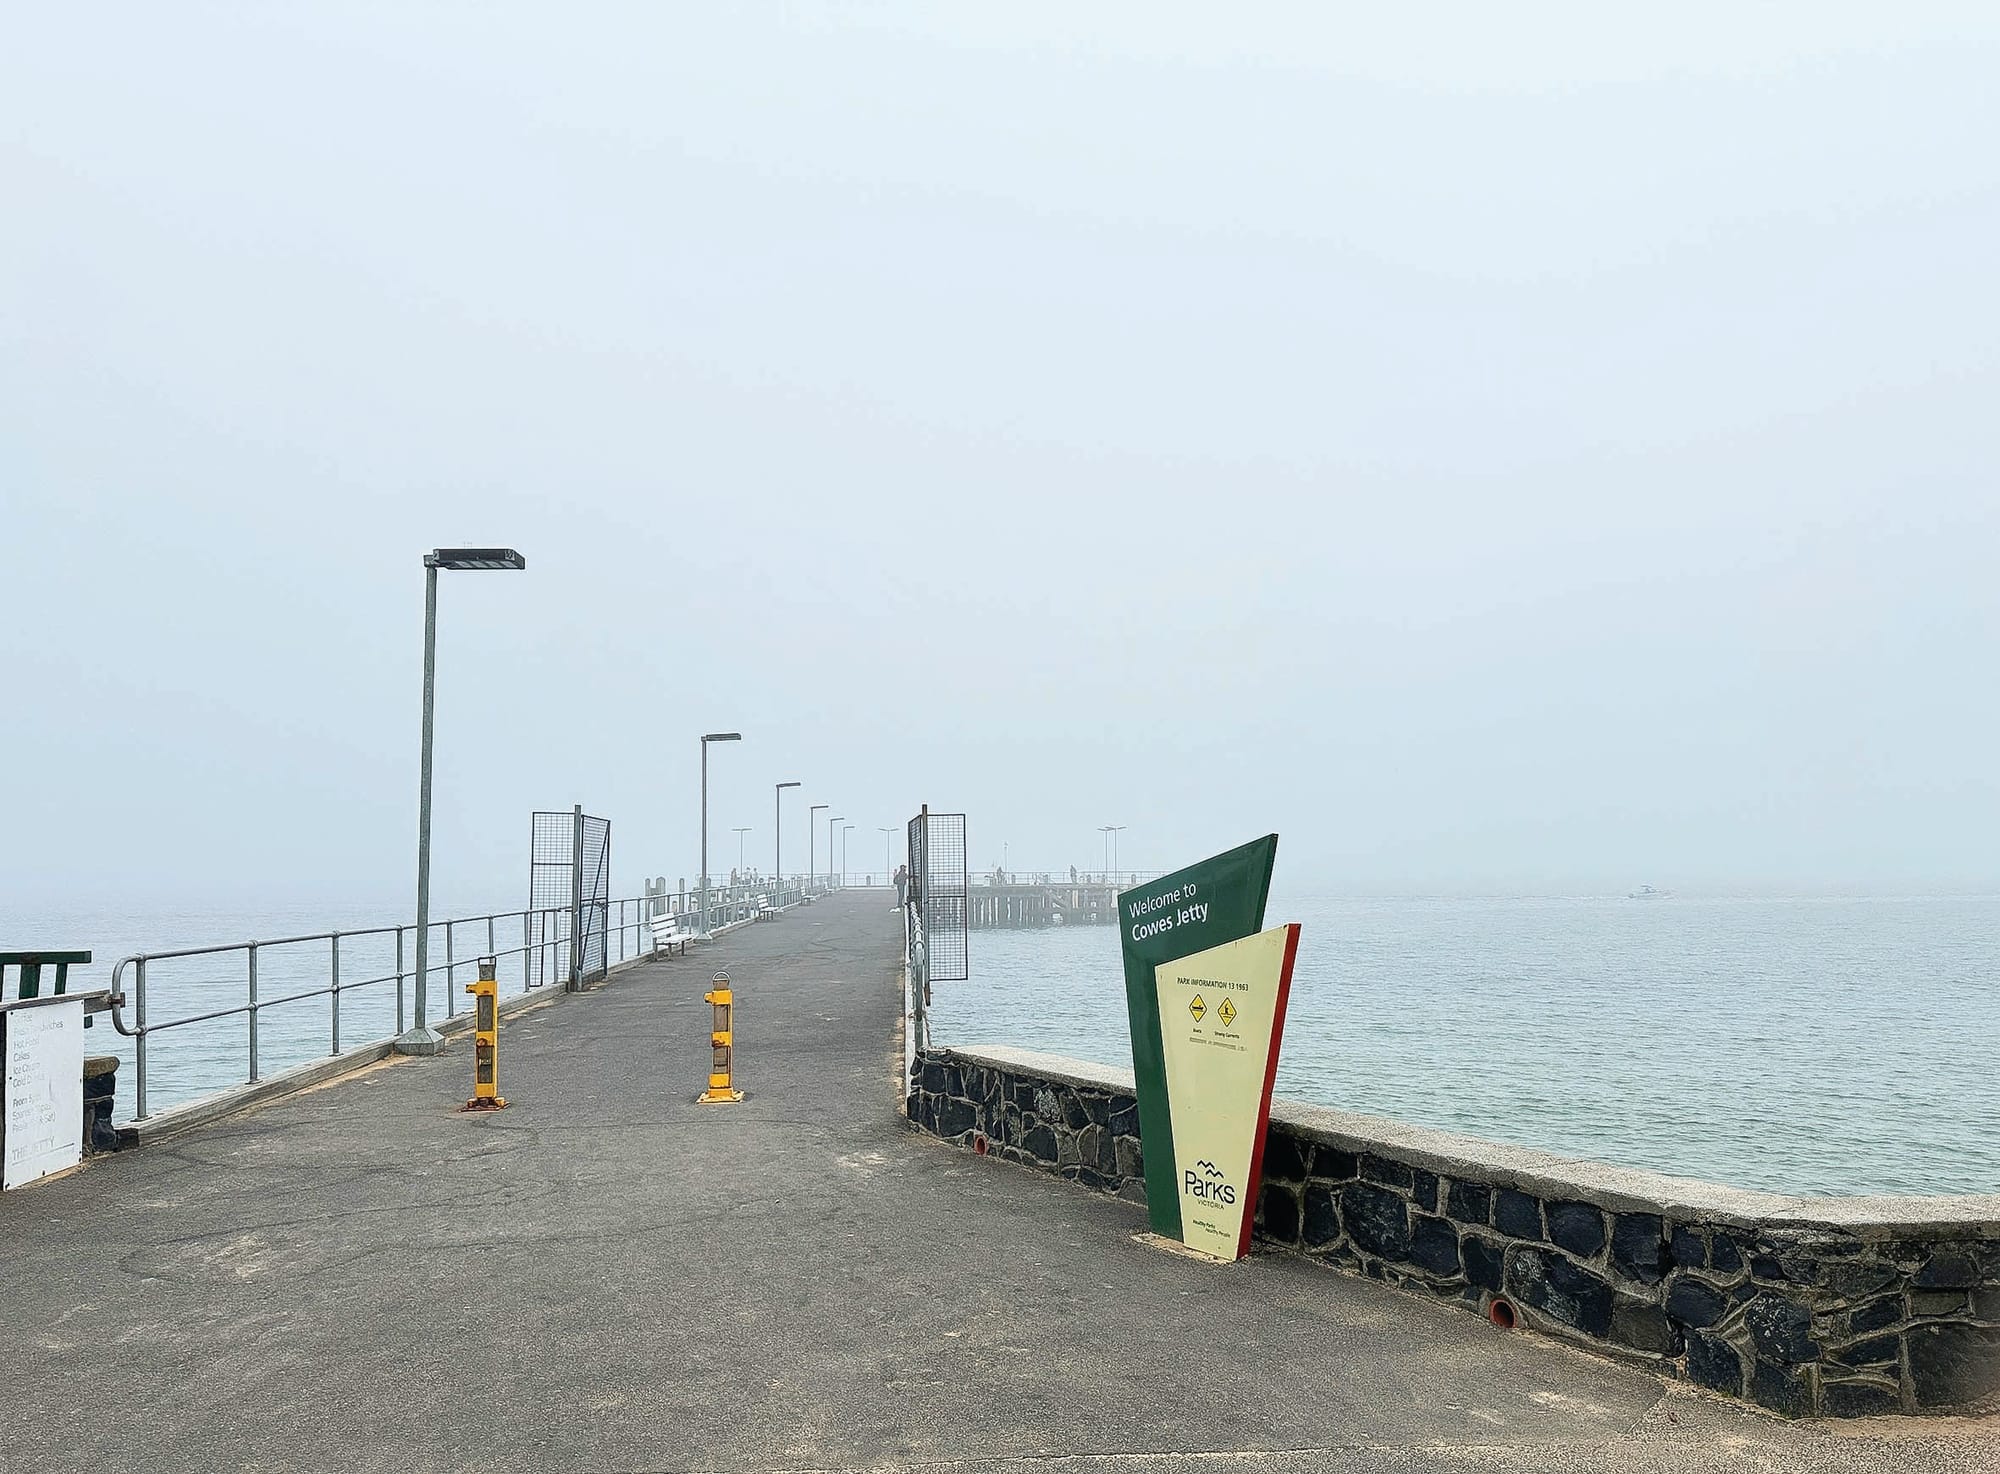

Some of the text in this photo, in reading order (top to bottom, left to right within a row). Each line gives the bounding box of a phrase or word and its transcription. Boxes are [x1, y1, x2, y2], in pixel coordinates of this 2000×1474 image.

[1129, 883, 1197, 918] Welcome to
[1132, 902, 1209, 941] Cowes Jetty
[1177, 976, 1249, 991] PARK INFORMATION 13 1963
[30, 1136, 55, 1155] ETTY
[1185, 1169, 1235, 1204] Parks
[1198, 1198, 1224, 1210] VICTORIA
